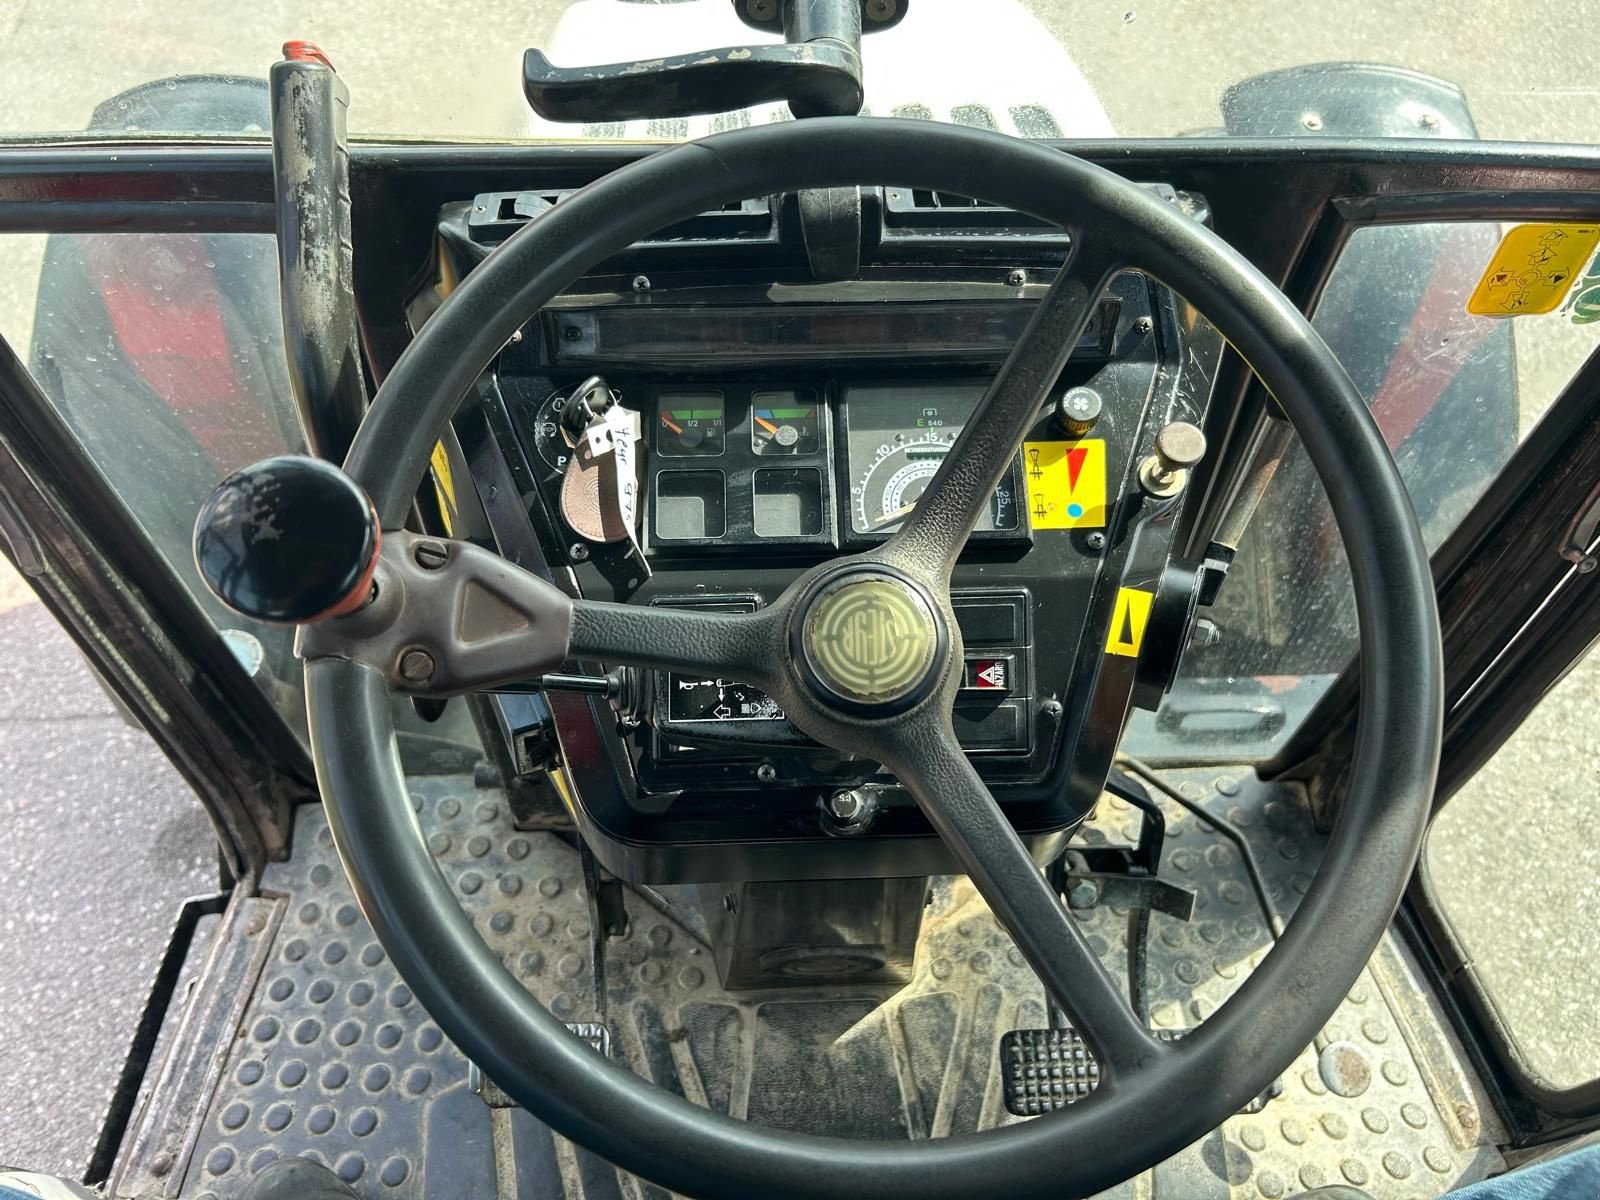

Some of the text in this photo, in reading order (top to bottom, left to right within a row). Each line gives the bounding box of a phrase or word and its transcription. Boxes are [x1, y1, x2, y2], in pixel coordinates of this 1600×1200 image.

[917, 419, 925, 427] E
[924, 432, 938, 442] 15
[876, 444, 890, 457] 10
[557, 456, 567, 466] P
[851, 486, 862, 495] 5
[1000, 491, 1011, 505] 25
[842, 609, 897, 665] STEYR
